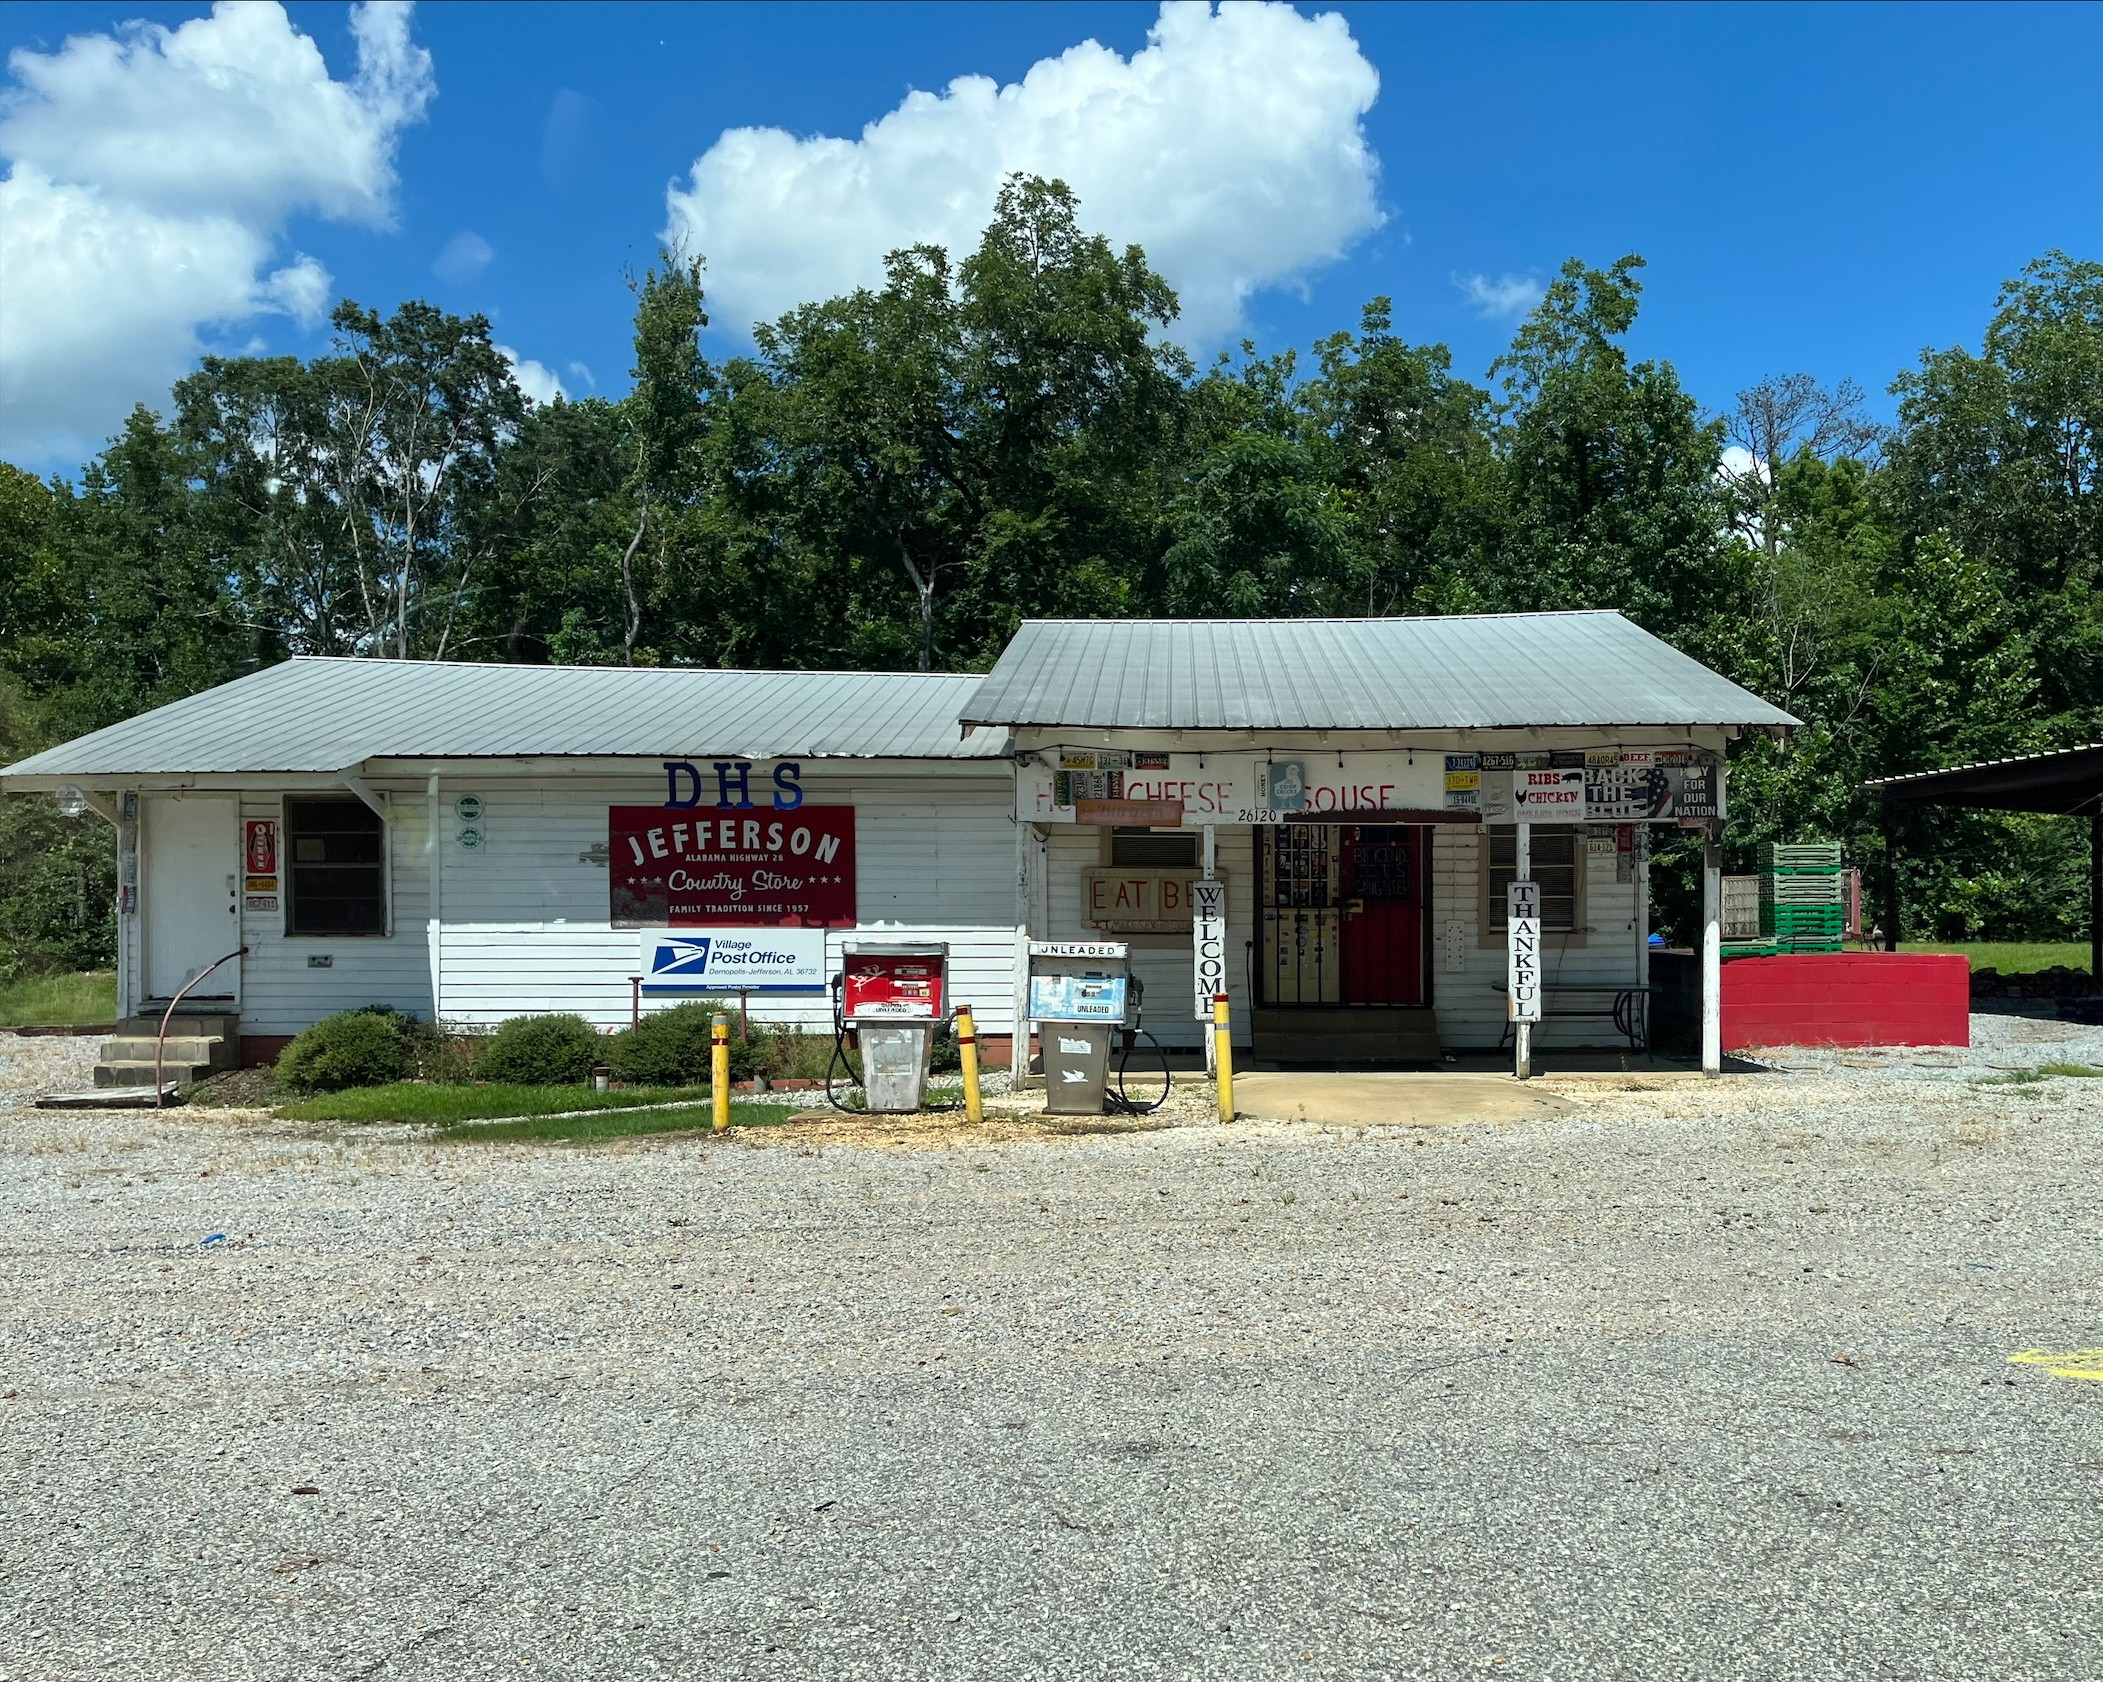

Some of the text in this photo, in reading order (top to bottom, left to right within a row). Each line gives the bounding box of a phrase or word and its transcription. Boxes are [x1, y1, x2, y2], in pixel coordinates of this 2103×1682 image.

[1528, 772, 1561, 786] RIBS
[1584, 767, 1643, 785] BACK
[1680, 766, 1709, 778] PY
[663, 762, 803, 810] DHS
[1683, 779, 1707, 790] FOR
[1128, 781, 1235, 814] CHEESE
[1528, 790, 1579, 804] CHICKEN
[1588, 785, 1633, 801] THE
[1683, 792, 1707, 804] OUR
[1239, 808, 1277, 823] 26120
[1674, 805, 1717, 817] NATION
[628, 820, 841, 866] JEFFERSON
[685, 853, 784, 862] ALABAMA HIGHWAY 28
[668, 869, 804, 901] Country Store
[1093, 880, 1194, 909] EAT BE
[669, 904, 809, 914] FAMILY TRADITION SINCE 1957
[715, 939, 752, 951] Village
[1041, 945, 1115, 955] UNLEADED
[1194, 886, 1223, 1015] WELCOME
[1512, 886, 1540, 1017] THANKFUL
[711, 951, 796, 964] Post Office
[1077, 1005, 1110, 1014] UNLEADED
